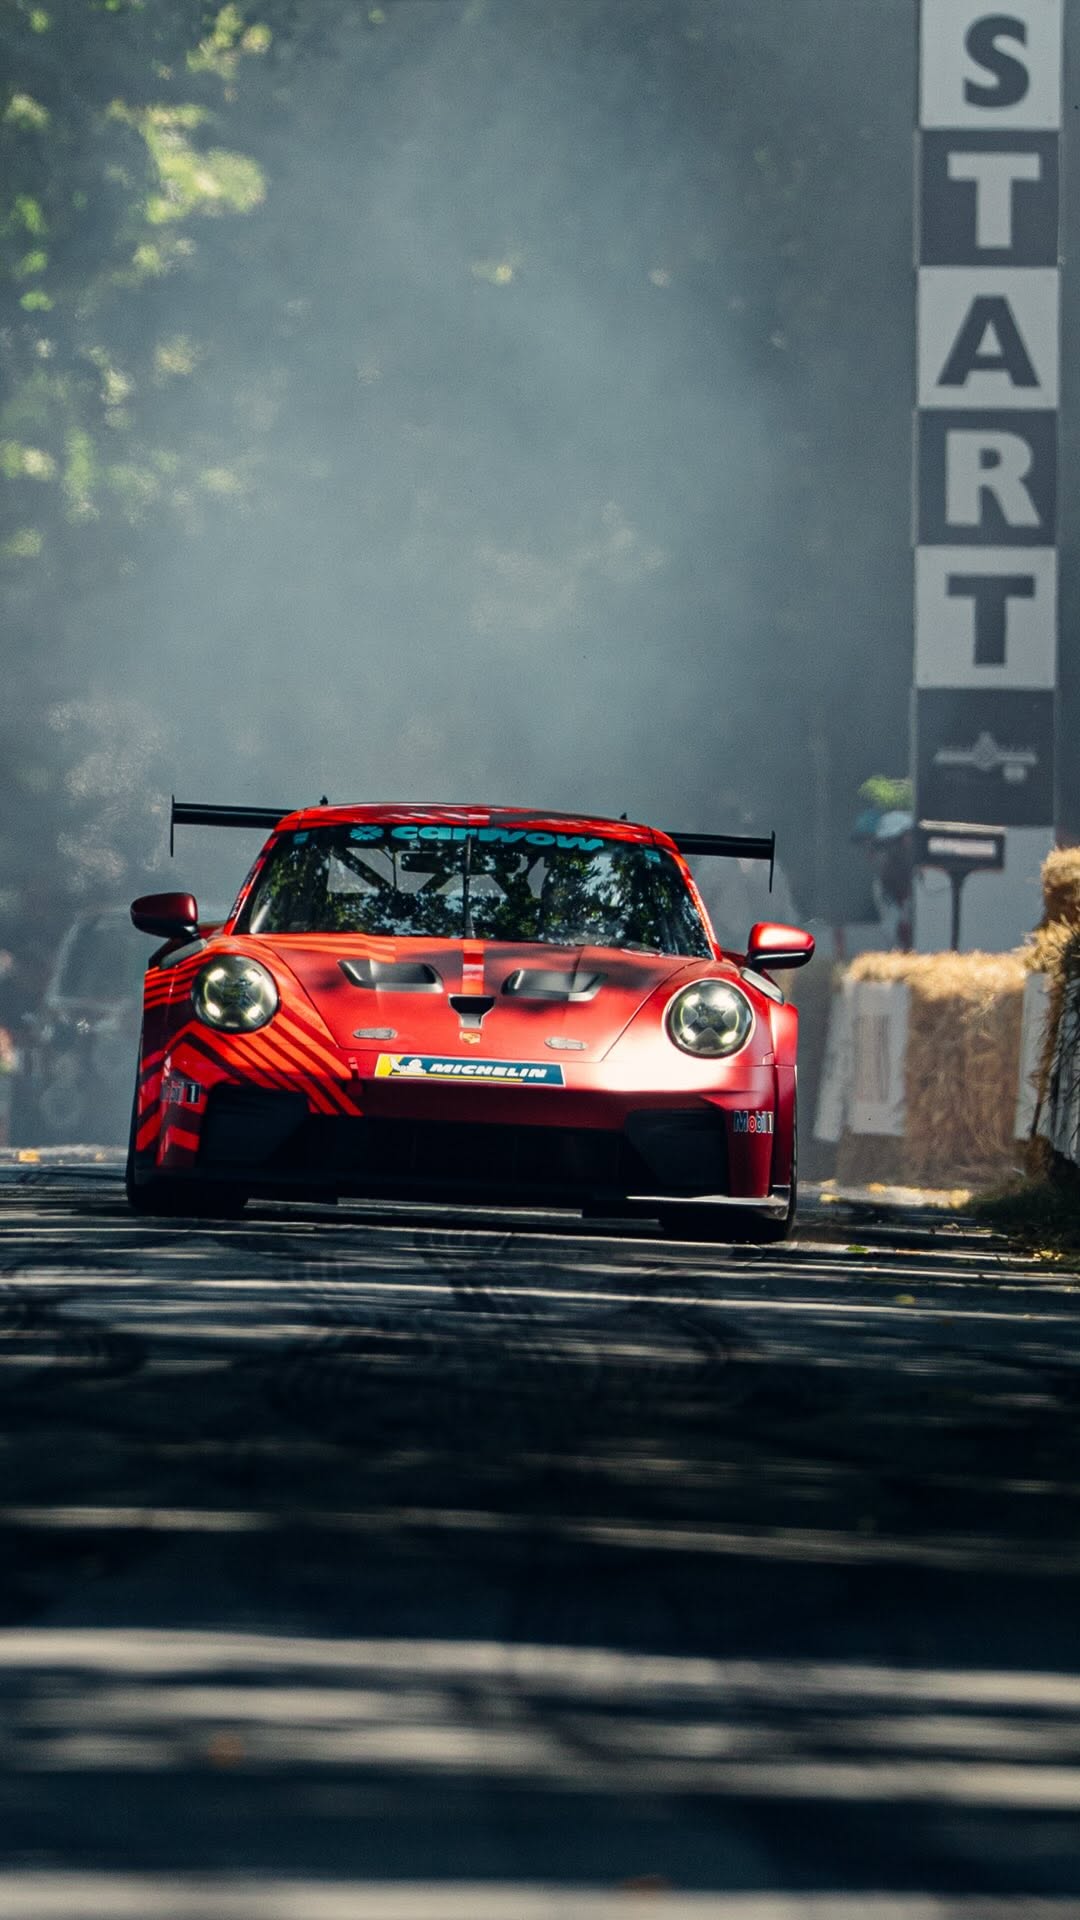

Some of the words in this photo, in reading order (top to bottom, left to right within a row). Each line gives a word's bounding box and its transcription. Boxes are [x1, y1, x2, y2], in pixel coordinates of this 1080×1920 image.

[936, 14, 1041, 668] START
[391, 826, 604, 850] carwow
[429, 1063, 547, 1078] MICHELIN
